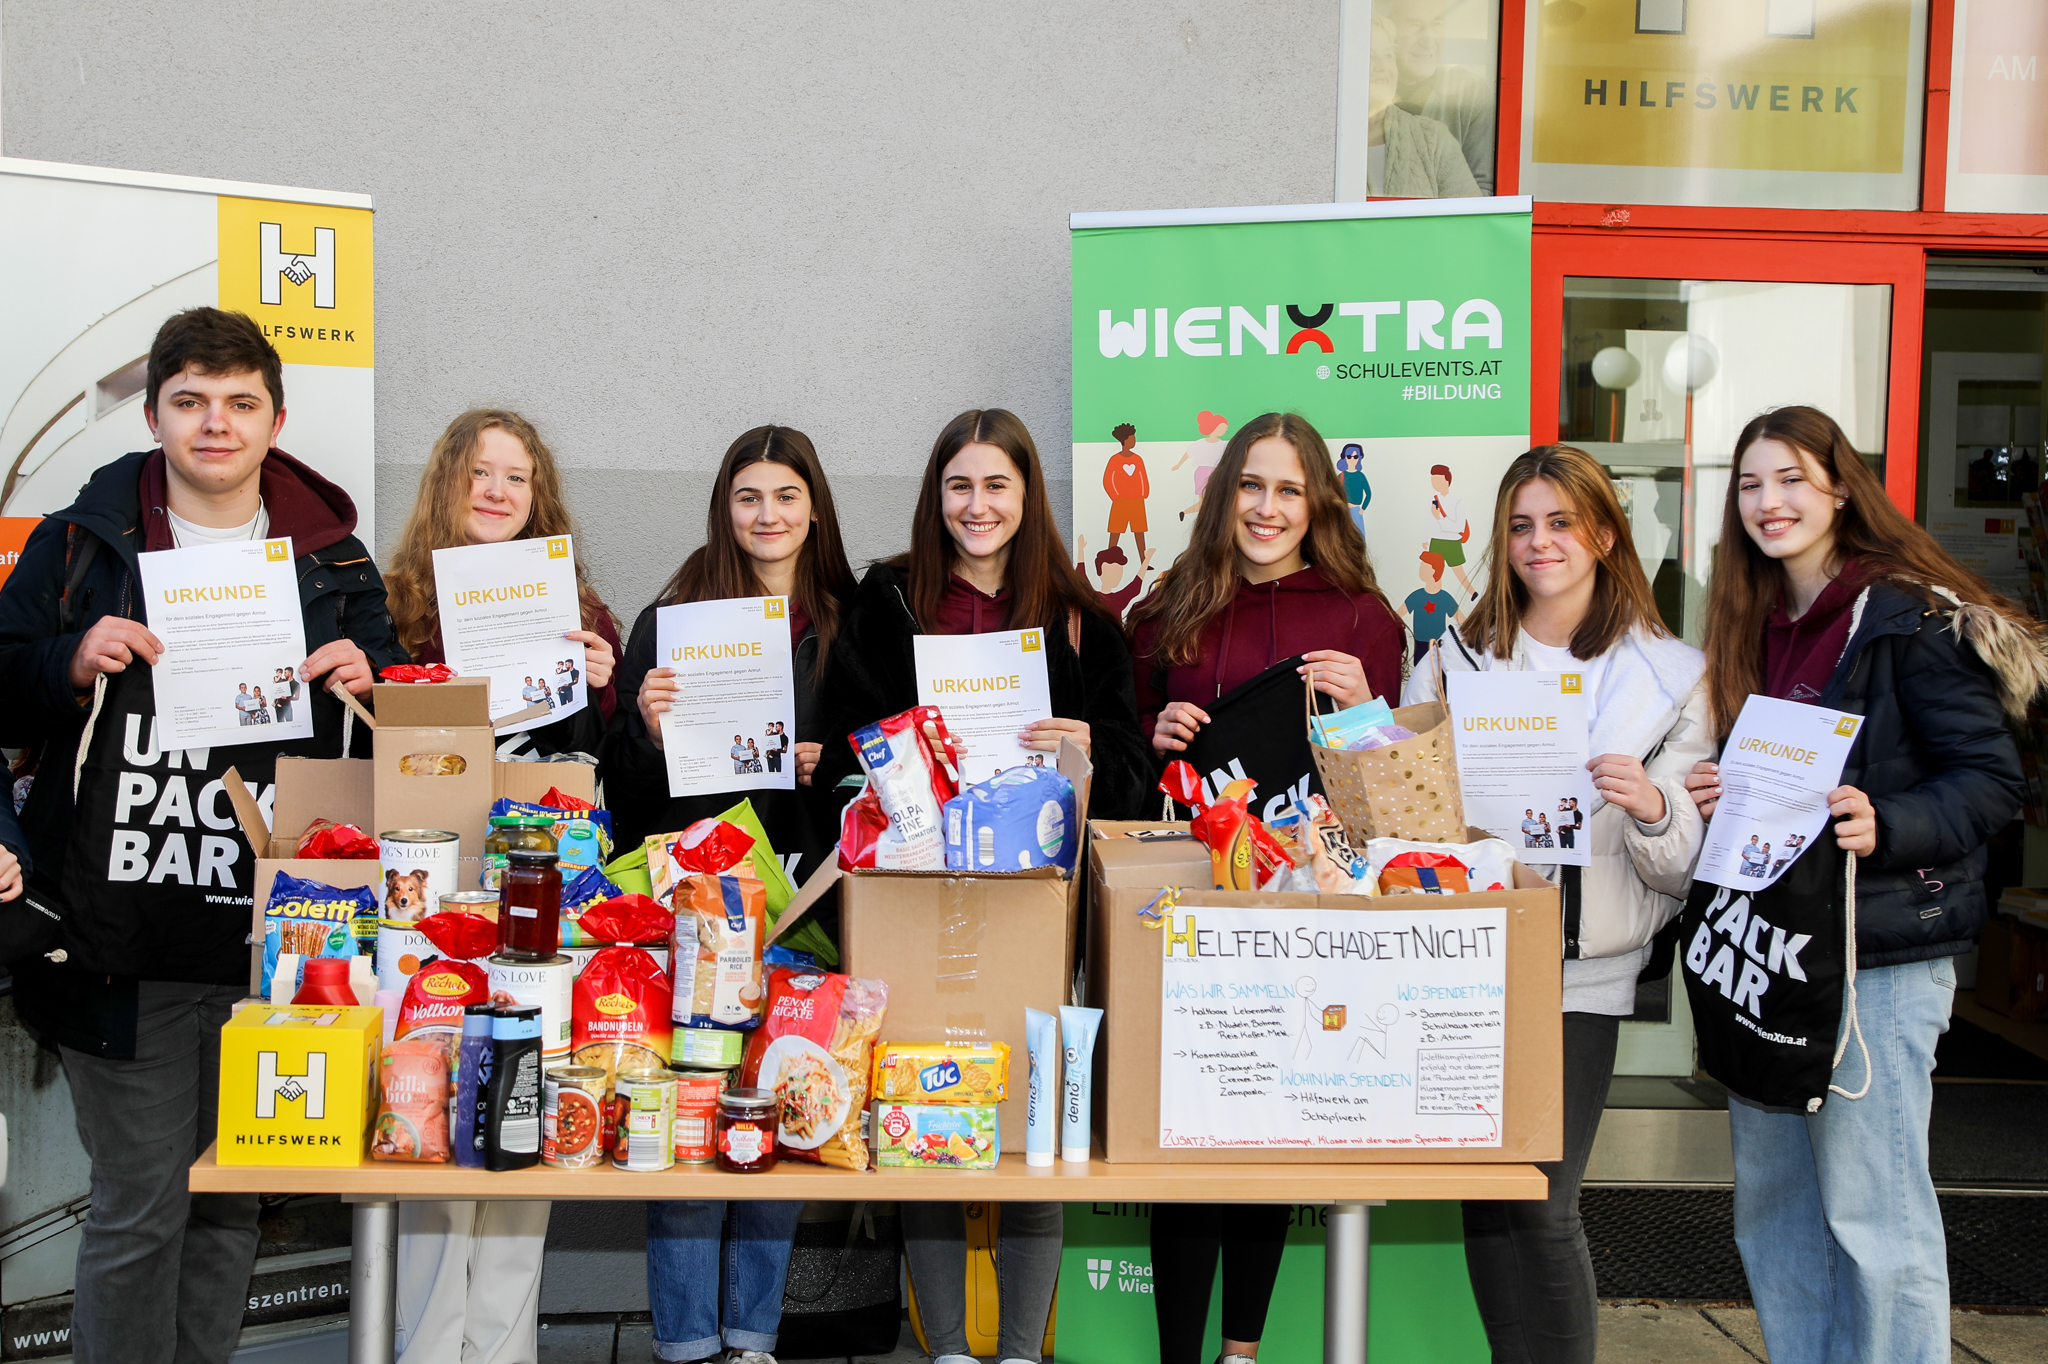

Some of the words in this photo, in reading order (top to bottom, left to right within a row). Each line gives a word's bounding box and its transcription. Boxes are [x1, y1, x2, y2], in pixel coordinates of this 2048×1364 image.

[1584, 79, 1858, 113] HILFSWERK
[263, 324, 355, 342] LFSWERK
[1099, 298, 1503, 359] WIENXTRA
[1336, 360, 1503, 380] SCHULEVENTS.AT
[1401, 384, 1502, 401] #BILDUNG
[164, 585, 267, 604] URKUNDE
[454, 582, 548, 606] URKUNDE
[205, 611, 236, 620] Engagement
[672, 642, 762, 661] URKUNDE
[932, 675, 1021, 693] URKUNDE
[1463, 716, 1558, 731] URKUNDE
[868, 747, 886, 763] Chef
[1738, 736, 1819, 766] URKUNDE
[114, 772, 276, 833] PACK
[890, 803, 924, 824] OLPA
[108, 829, 240, 889] BAR
[407, 847, 441, 859] LOVE
[1166, 915, 1290, 959] HELFEN
[1295, 927, 1410, 961] SCHADET
[1411, 924, 1497, 960] NICHT
[1705, 886, 1813, 983] PACK
[511, 971, 547, 984] LOVE
[1686, 921, 1769, 1019] BAR
[426, 975, 467, 992] Recheis
[1166, 981, 1199, 1000] WAS
[1201, 983, 1226, 1000] WIR
[1229, 983, 1296, 1000] SAMMELN
[1397, 983, 1420, 1001] WO
[1421, 985, 1478, 1000] SPENDET
[1479, 983, 1504, 998] MAN
[598, 996, 634, 1010] Recheis
[777, 996, 815, 1010] PENNE
[1191, 1006, 1229, 1016] haltbare
[1233, 1005, 1286, 1016] Lebensmittel
[413, 1003, 466, 1021] Vollkor
[771, 1005, 815, 1021] RIGATE
[1420, 1008, 1485, 1019] Sammelboxen
[588, 1021, 644, 1033] BANDNUDELN
[1421, 1021, 1469, 1031] Schulhaus
[1470, 1020, 1502, 1029] verteilt
[1440, 1034, 1473, 1042] Atrium
[1191, 1049, 1259, 1059] Kosmetikartikel
[1420, 1052, 1501, 1063] Wettkampfteilnahme
[1420, 1063, 1447, 1073] erfolgt
[389, 1076, 426, 1093] billa
[923, 1067, 958, 1091] TUC
[1280, 1068, 1325, 1087] WOHIN
[1325, 1072, 1347, 1087] WIR
[1350, 1072, 1412, 1088] SPENDEN
[1433, 1073, 1467, 1082] Produkte
[1468, 1073, 1480, 1081] mit
[1482, 1073, 1499, 1081] dem
[386, 1087, 413, 1104] bio
[1420, 1084, 1472, 1093] Klassennamen
[1461, 1092, 1482, 1101] Ende
[1300, 1092, 1351, 1105] Hilfswerk
[1353, 1097, 1370, 1105] am
[1301, 1108, 1367, 1124] Schöpfwerk
[236, 1134, 342, 1146] HILFSWERK
[1208, 1135, 1265, 1147] Schulinterner
[1318, 1135, 1349, 1145] Klasse
[1351, 1136, 1364, 1144] mit
[1366, 1136, 1383, 1144] den
[1386, 1136, 1413, 1145] meisten
[1414, 1133, 1453, 1146] Spenden
